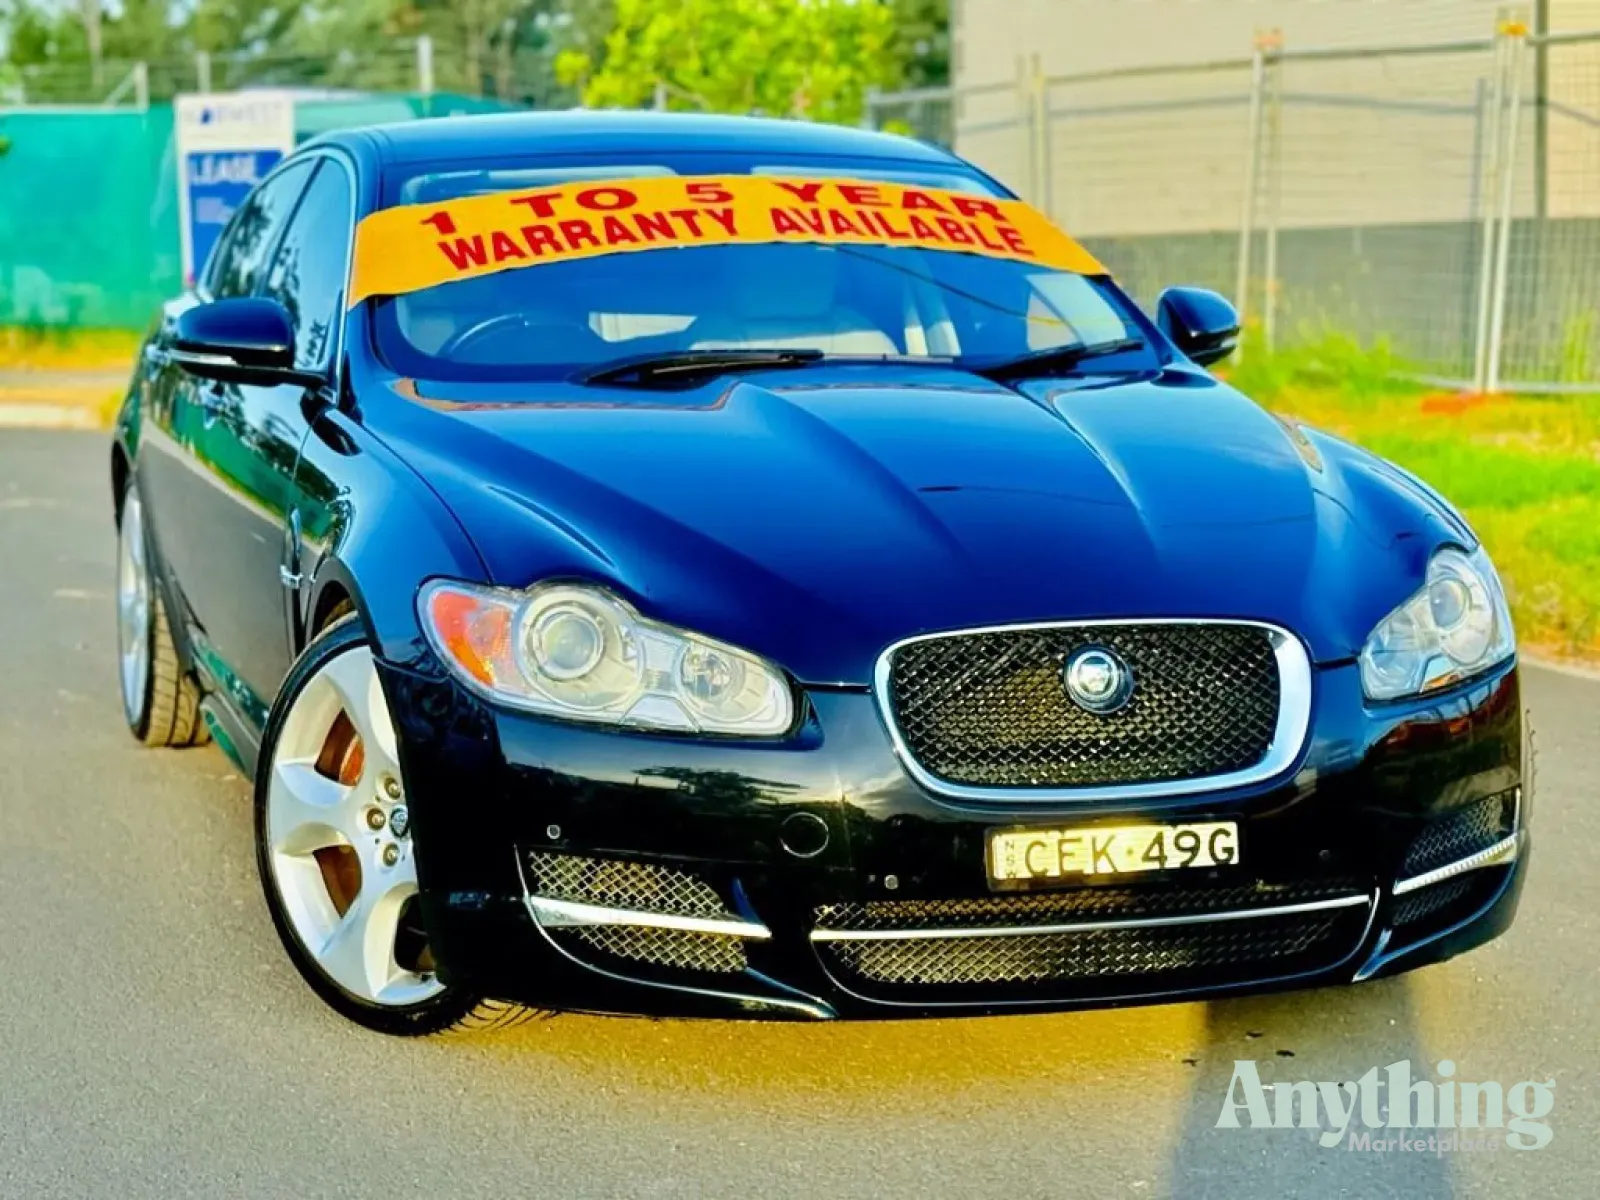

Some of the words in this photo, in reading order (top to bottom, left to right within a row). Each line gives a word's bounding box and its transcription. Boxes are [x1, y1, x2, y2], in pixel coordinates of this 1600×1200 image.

[421, 211, 457, 234] 1
[510, 188, 638, 218] TO
[686, 183, 735, 204] 5
[772, 181, 1010, 222] YEAR
[437, 207, 738, 271] WARRANTY
[770, 207, 1035, 256] AVAILABLE
